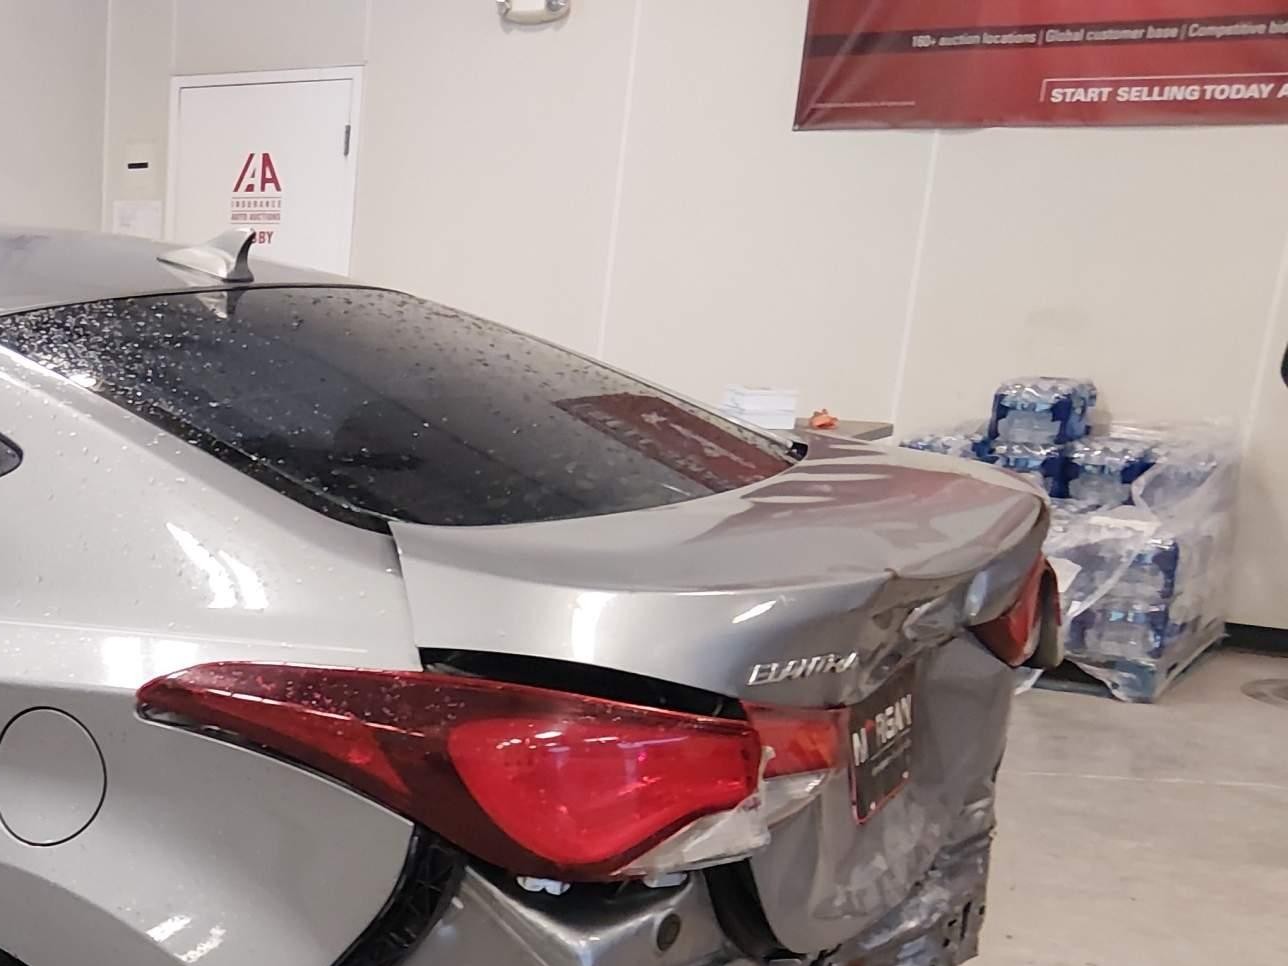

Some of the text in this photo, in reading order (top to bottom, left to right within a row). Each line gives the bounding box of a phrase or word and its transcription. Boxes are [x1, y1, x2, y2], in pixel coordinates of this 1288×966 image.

[1045, 28, 1085, 43] Global
[1085, 28, 1145, 41] customer
[1146, 25, 1179, 39] base
[1188, 22, 1268, 38] Competitive
[1050, 87, 1114, 103] START
[1116, 85, 1201, 102] SELLING
[1202, 83, 1275, 101] TODAY
[231, 200, 281, 208] INSURANCE
[746, 651, 858, 687] ELANTRA
